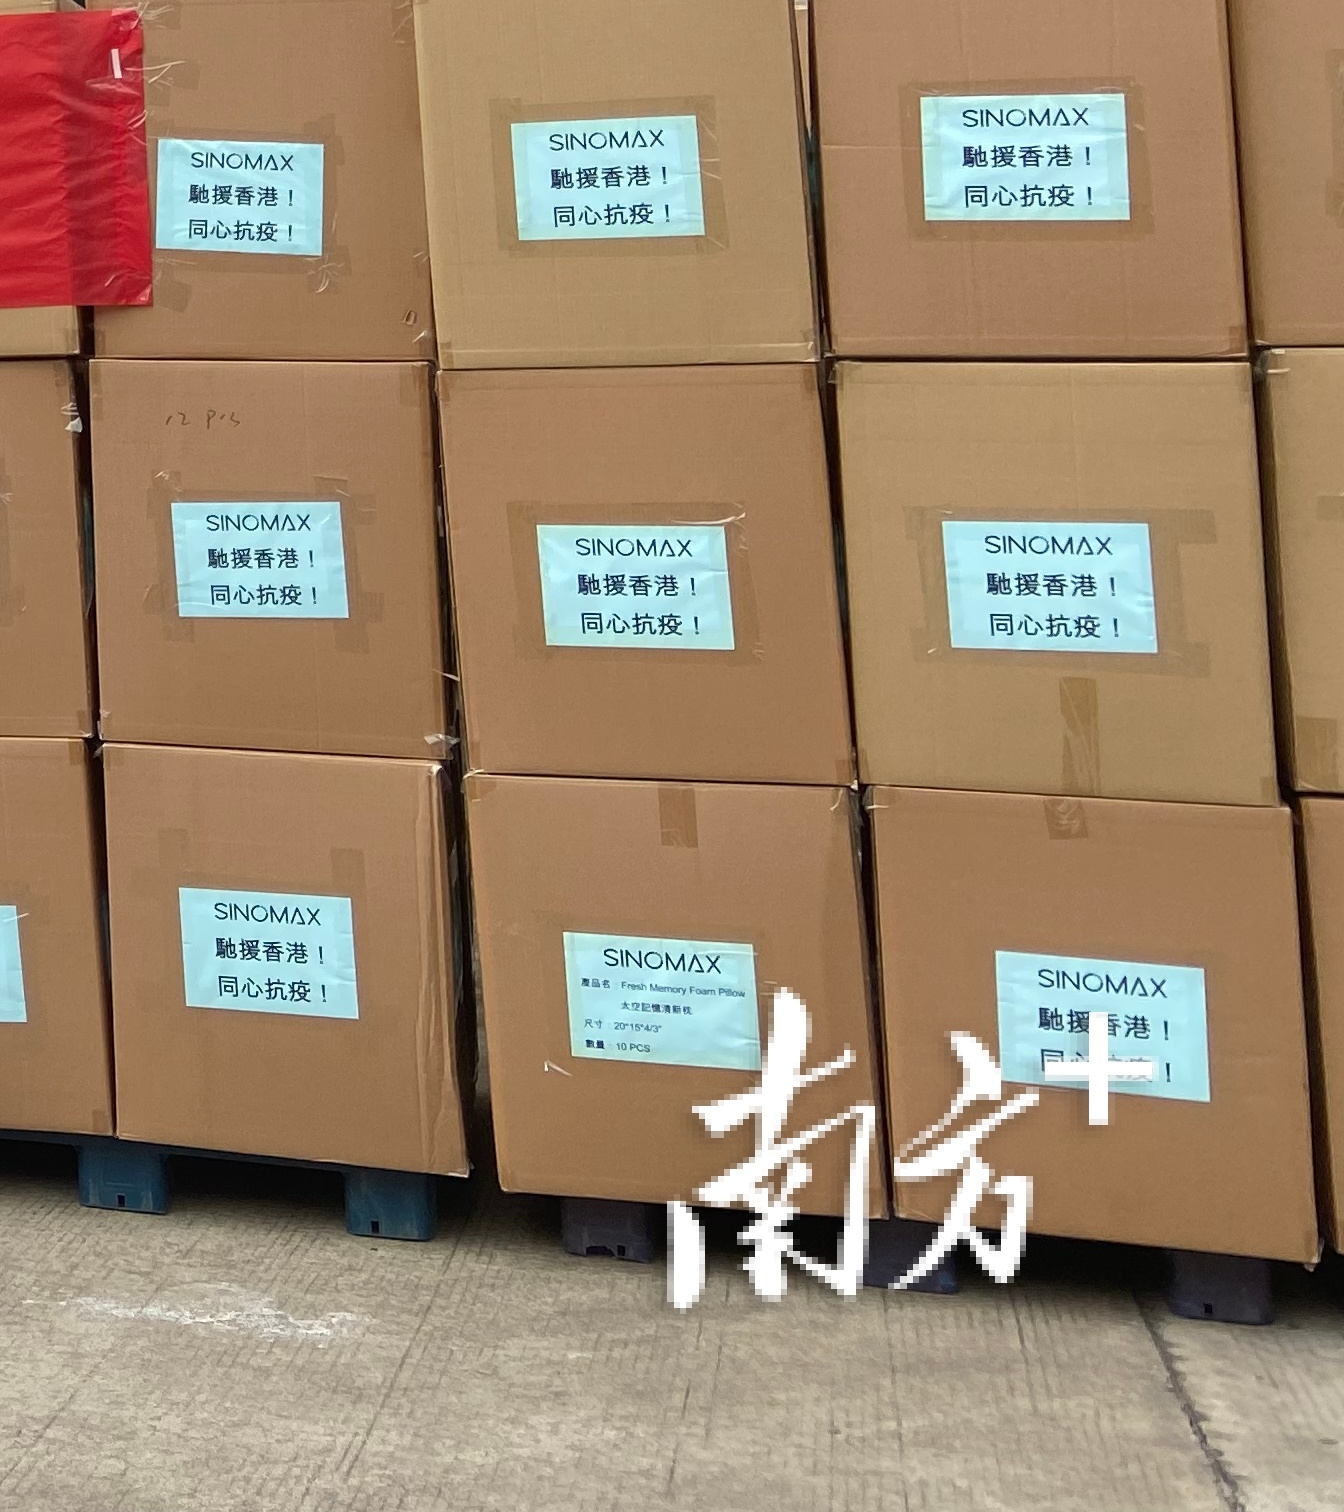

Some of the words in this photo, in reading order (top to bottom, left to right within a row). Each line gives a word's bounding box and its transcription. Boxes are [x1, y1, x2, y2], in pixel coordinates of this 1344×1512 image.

[963, 108, 1089, 127] SINOMAX
[550, 130, 664, 151] SINOMAX
[191, 152, 293, 171] SINOMAX
[962, 144, 1090, 168] 馳援香港！
[551, 165, 666, 189] 馳援香港！
[188, 184, 292, 206] 馳援香港！
[965, 184, 1092, 208] 同心抗疫！
[554, 203, 669, 227] 同心抗疫！
[189, 219, 292, 242] 同心抗疫！
[206, 514, 310, 531] SINOMAX
[576, 538, 692, 557] SINOMAX
[985, 536, 1112, 555] SINOMAX
[208, 548, 313, 569] 馳援香港！
[211, 584, 316, 605] 同心抗疫！
[578, 573, 695, 596] 馳援香港！
[987, 572, 1115, 596] 馳援香港！
[581, 613, 699, 636] 同心抗疫！
[990, 614, 1118, 638] 同心抗疫！
[215, 903, 321, 926] SINOMAX
[216, 938, 323, 964] 馳援香港！
[604, 949, 721, 974] SINOMAX
[218, 976, 326, 1002] 同心抗疫！
[621, 981, 647, 991] Fresh
[650, 983, 686, 995] Memory
[689, 986, 715, 996] Foam
[718, 988, 746, 998] Pillow
[1038, 969, 1167, 998] SINOMAX
[616, 1042, 627, 1051] 10
[630, 1043, 651, 1053] PCS
